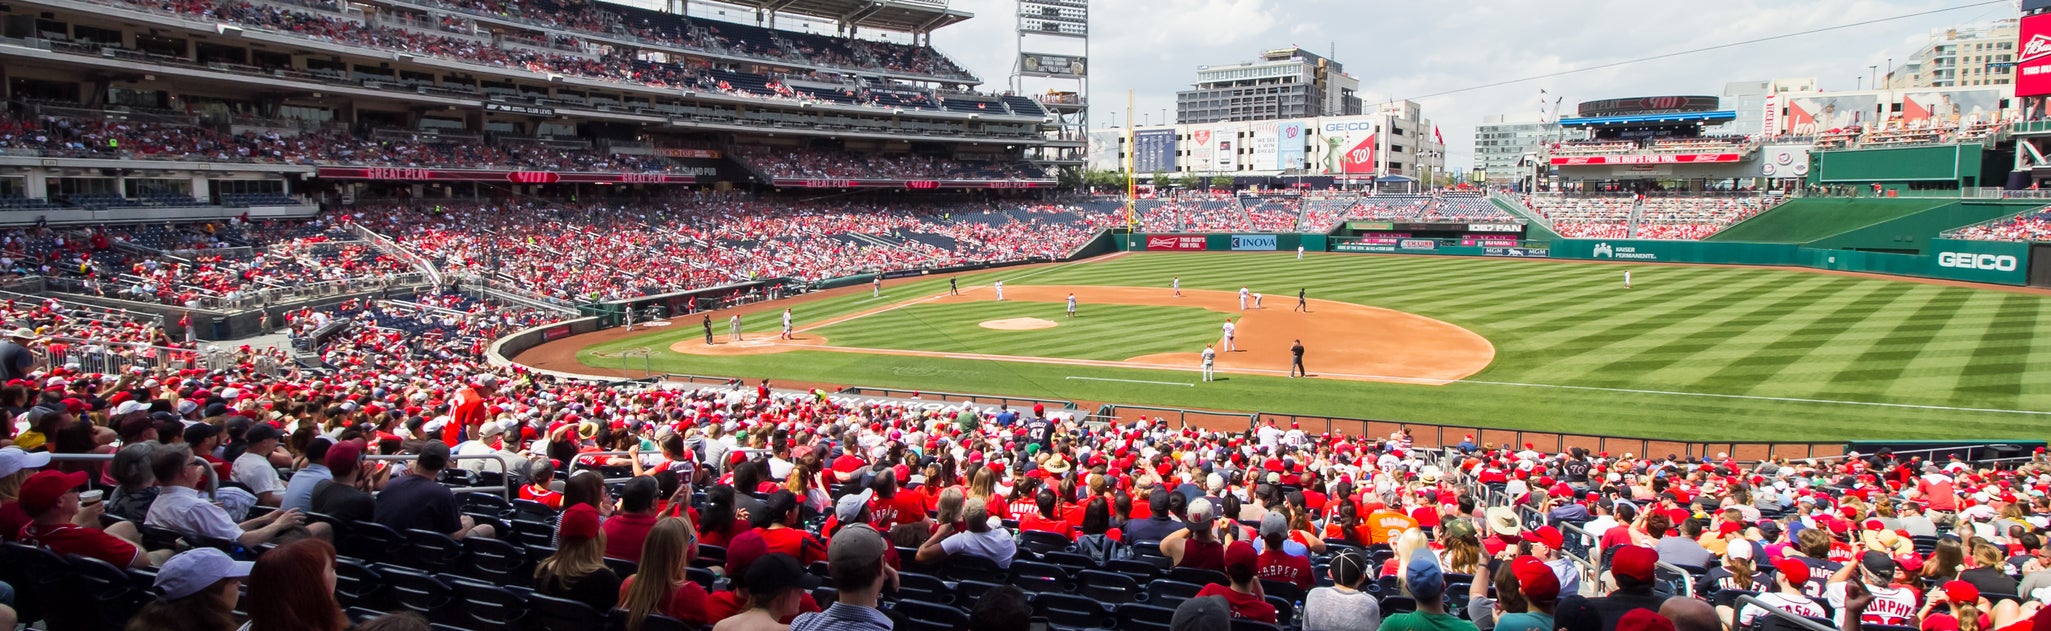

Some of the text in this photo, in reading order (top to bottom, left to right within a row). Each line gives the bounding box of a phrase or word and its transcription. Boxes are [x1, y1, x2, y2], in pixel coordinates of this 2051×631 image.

[2023, 66, 2040, 76] THIS
[1325, 122, 1369, 131] GEICO
[1622, 155, 1643, 163] BUD'S
[1645, 155, 1659, 163] FOR
[368, 168, 430, 180] GREAT PLAY
[622, 173, 666, 183] GREAT PLAY
[807, 180, 850, 188] GREAT PLAY
[1496, 224, 1522, 232] FAN
[1243, 238, 1276, 247] INOVA
[1938, 251, 2017, 272] GEICO
[1030, 428, 1044, 440] 47
[1290, 437, 1299, 445] 31
[1192, 512, 1201, 522] W
[1810, 567, 1834, 579] ARPE
